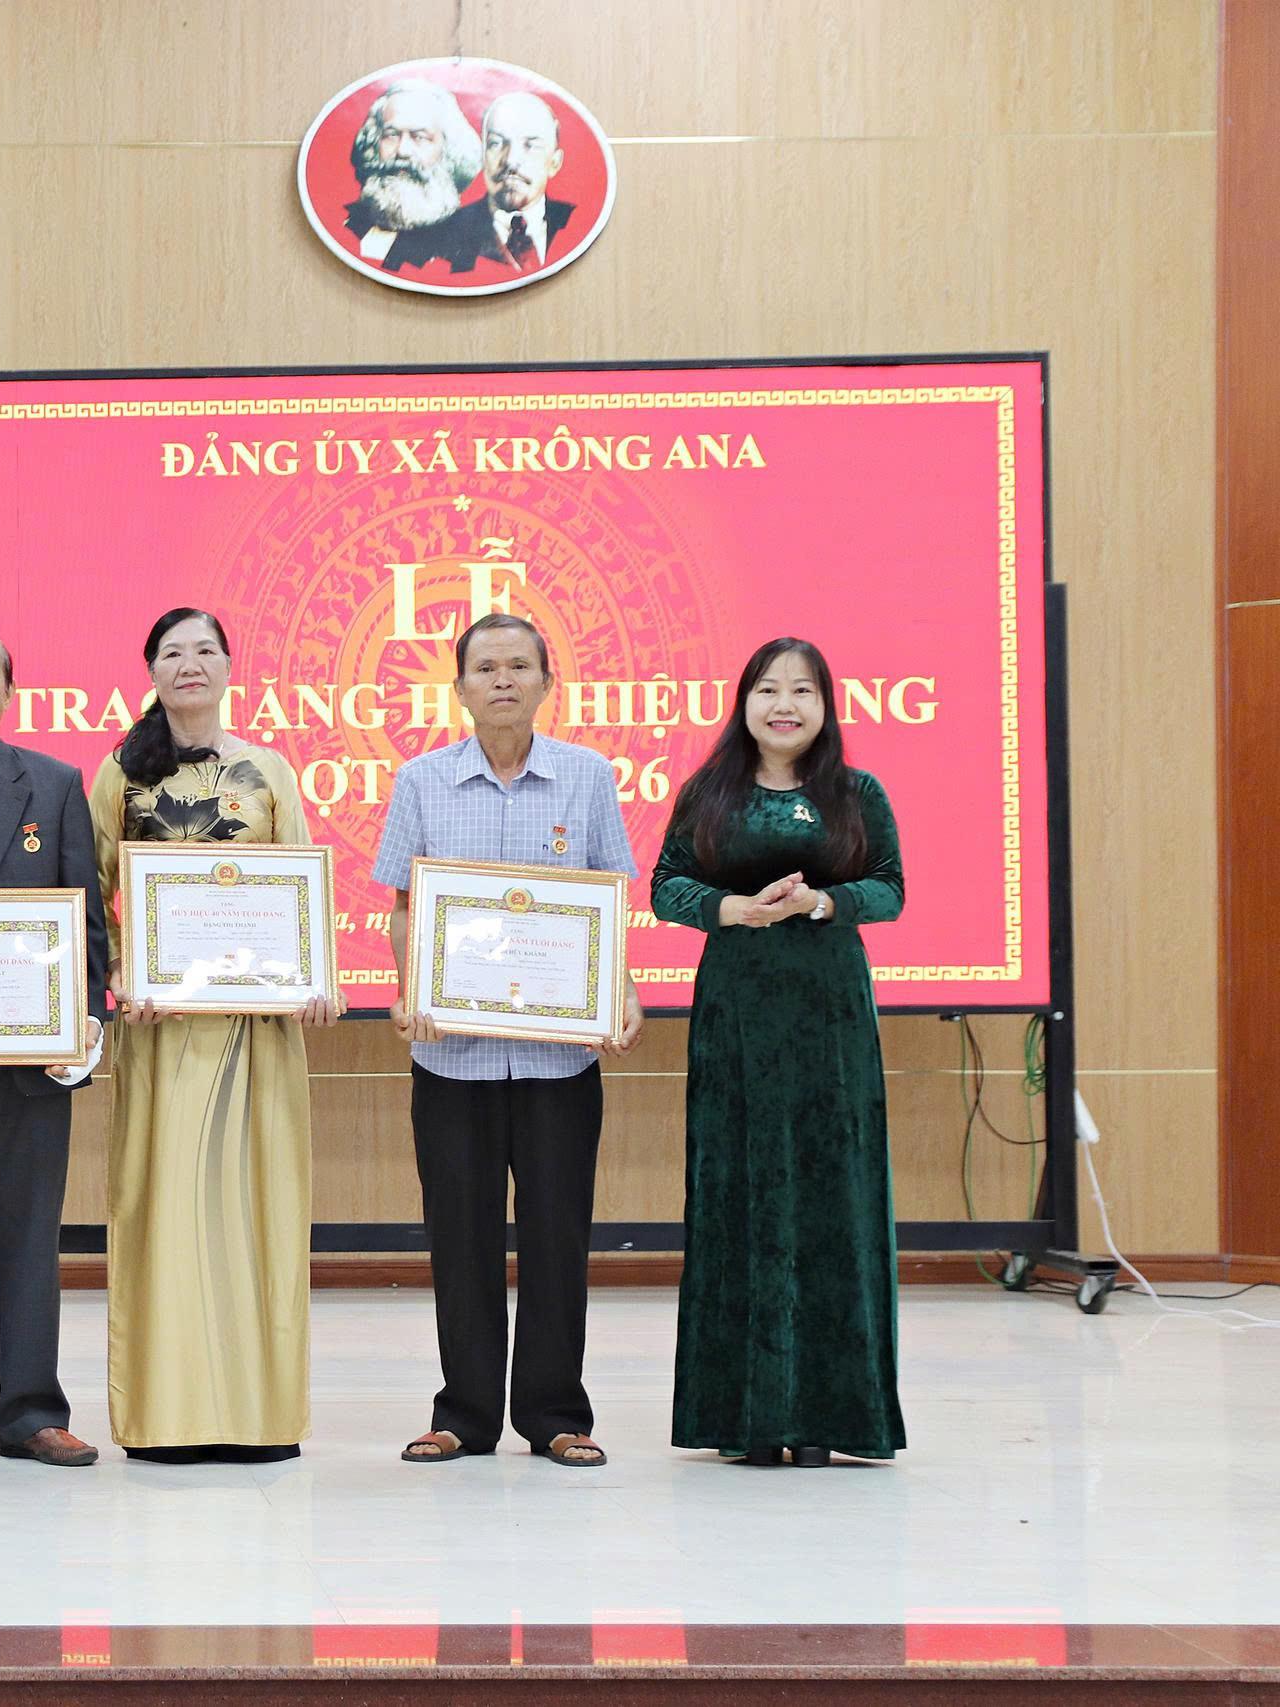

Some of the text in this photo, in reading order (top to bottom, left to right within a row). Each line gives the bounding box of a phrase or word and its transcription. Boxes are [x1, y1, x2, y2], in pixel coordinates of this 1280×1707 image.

[161, 425, 767, 477] ĐẢNG ỦY XÃ KRÔNG ANA
[383, 536, 528, 641] LỄ
[563, 673, 730, 738] HIỆU
[839, 676, 940, 725] NG
[290, 755, 670, 818] ỢT 26
